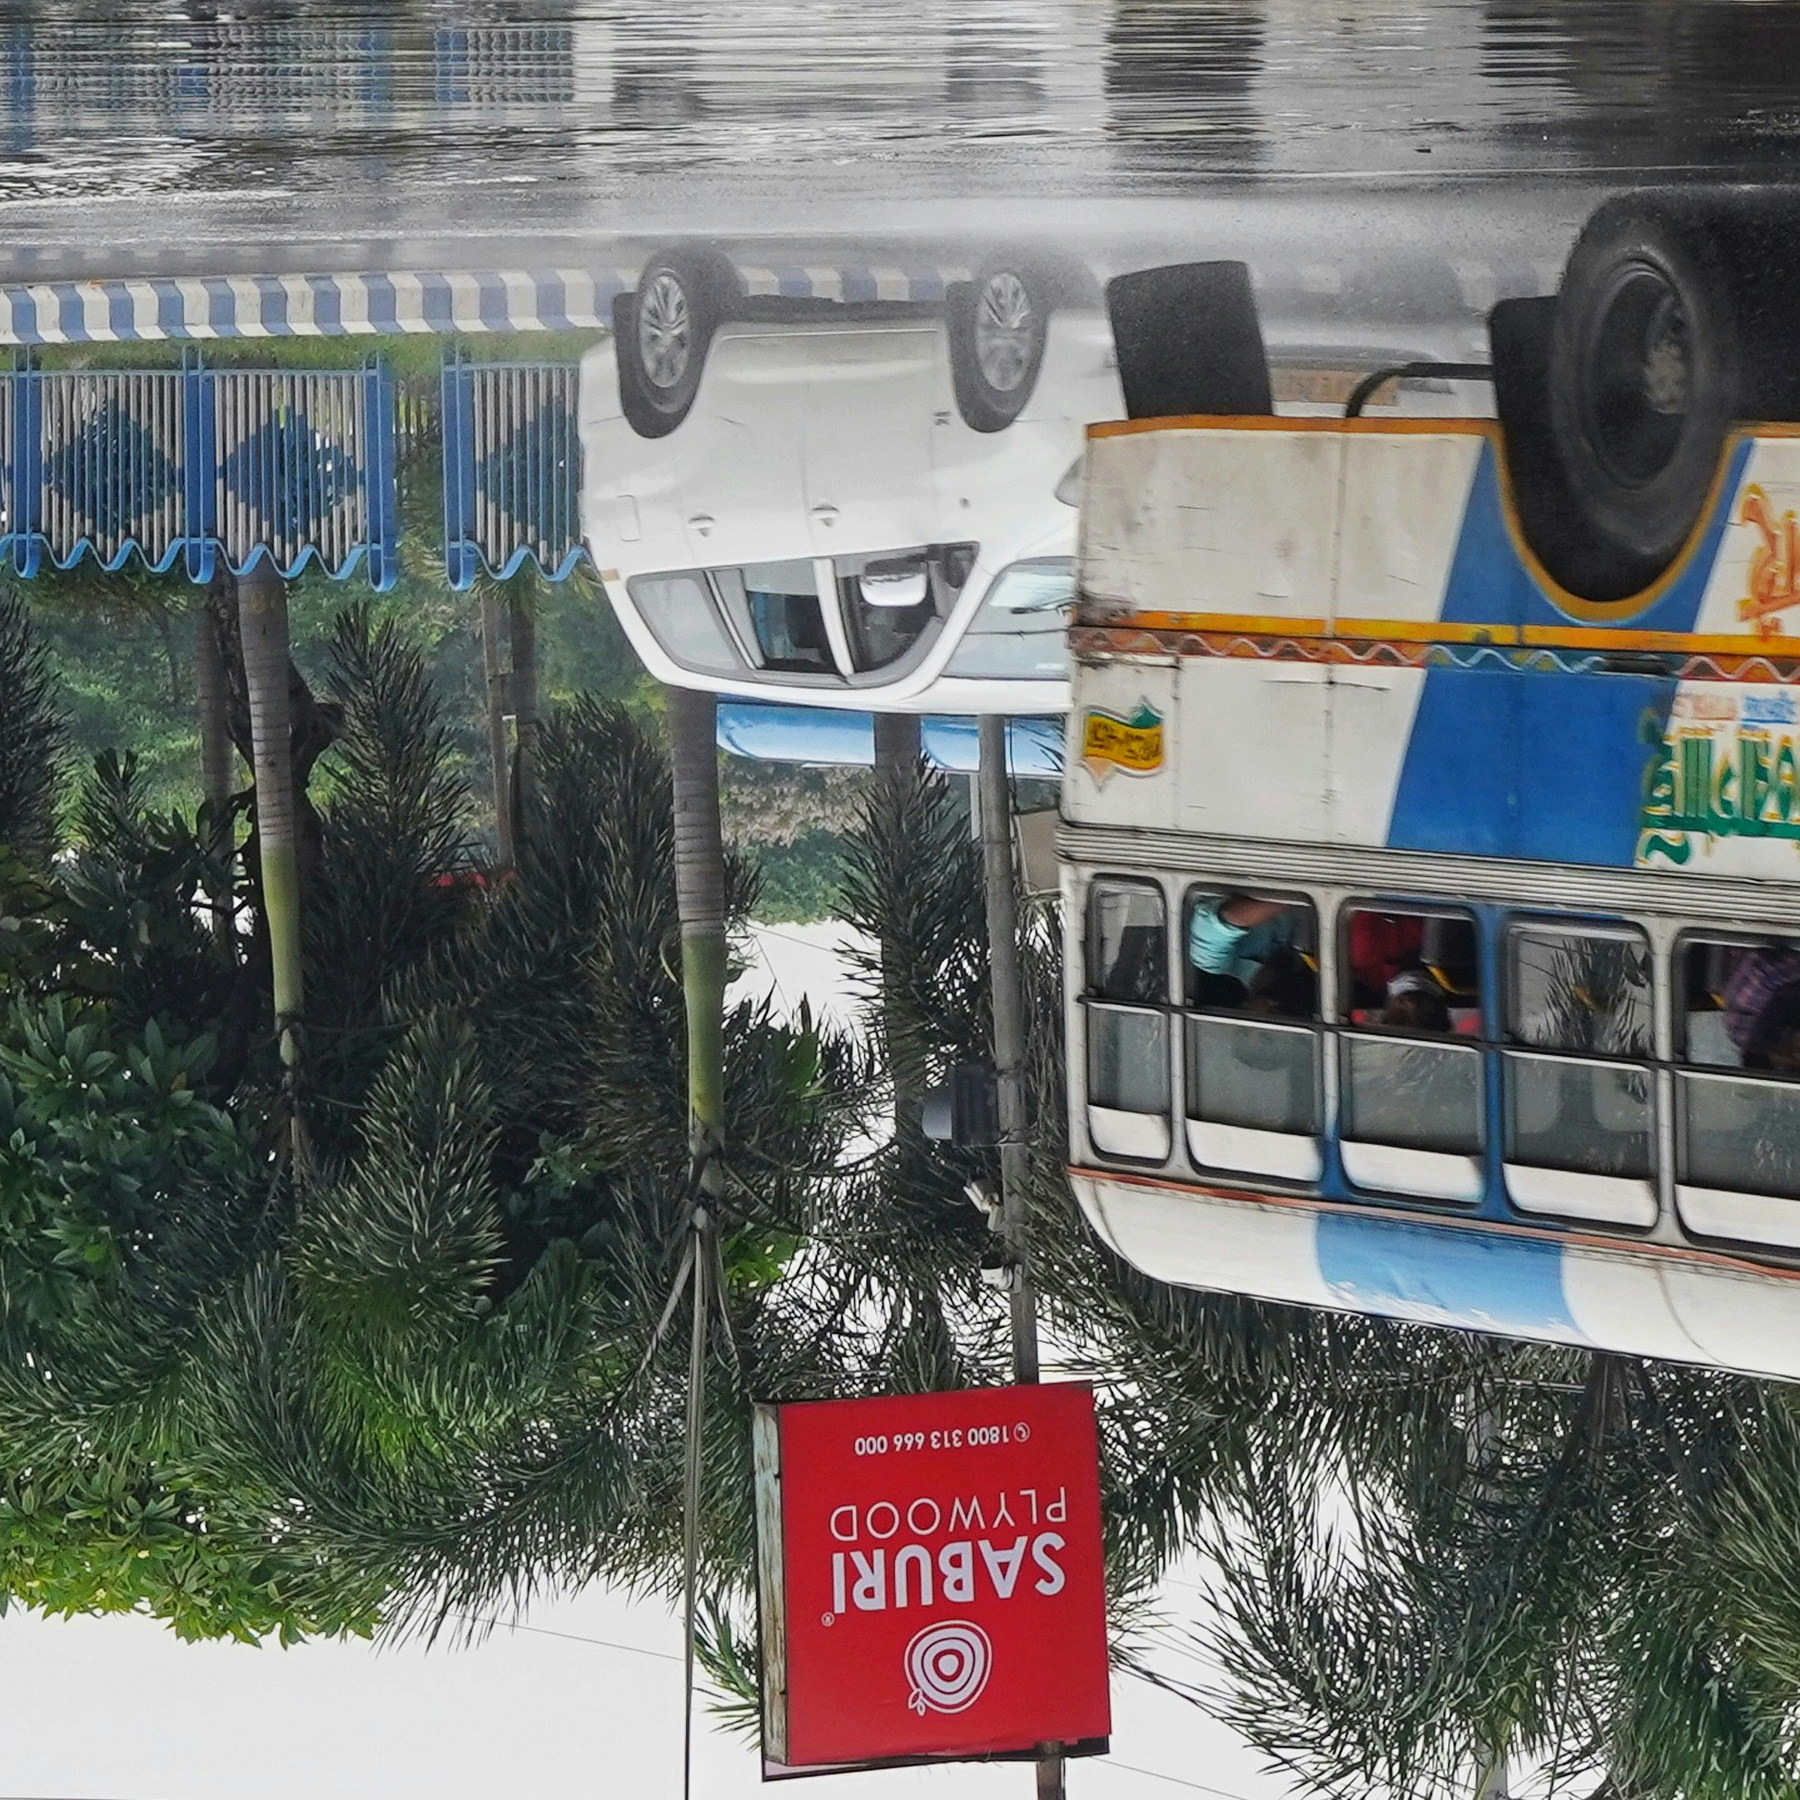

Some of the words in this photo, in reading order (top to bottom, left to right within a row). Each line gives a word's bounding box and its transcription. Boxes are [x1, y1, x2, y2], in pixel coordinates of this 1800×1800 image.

[855, 1430, 889, 1455] 000
[893, 1428, 925, 1451] 666
[930, 1426, 963, 1449] 313
[967, 1423, 1010, 1448] 1800
[829, 1486, 1068, 1542] PLYWOOD
[832, 1532, 1068, 1614] SABURI
